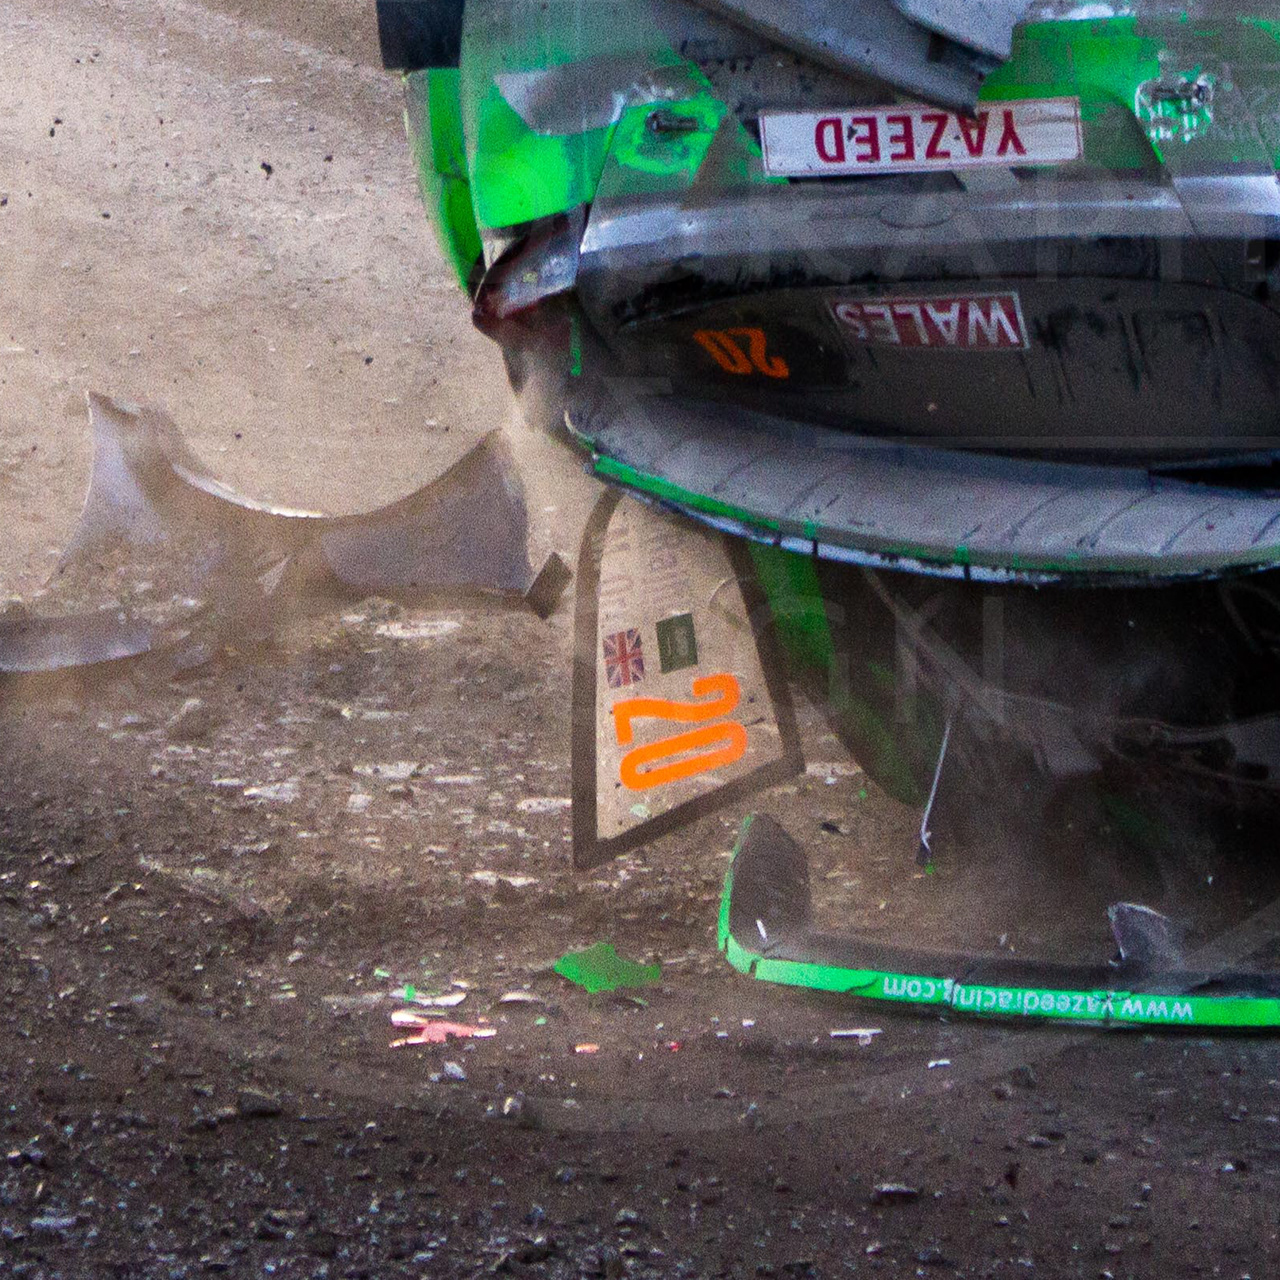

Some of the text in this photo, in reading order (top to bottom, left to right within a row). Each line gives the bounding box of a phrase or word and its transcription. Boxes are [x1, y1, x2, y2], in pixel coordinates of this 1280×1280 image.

[813, 108, 1028, 164] YAZEED
[835, 298, 1021, 347] WALES
[694, 328, 789, 379] 20
[612, 673, 748, 792] 20
[881, 975, 1195, 1020] www.yazeedracing.com
